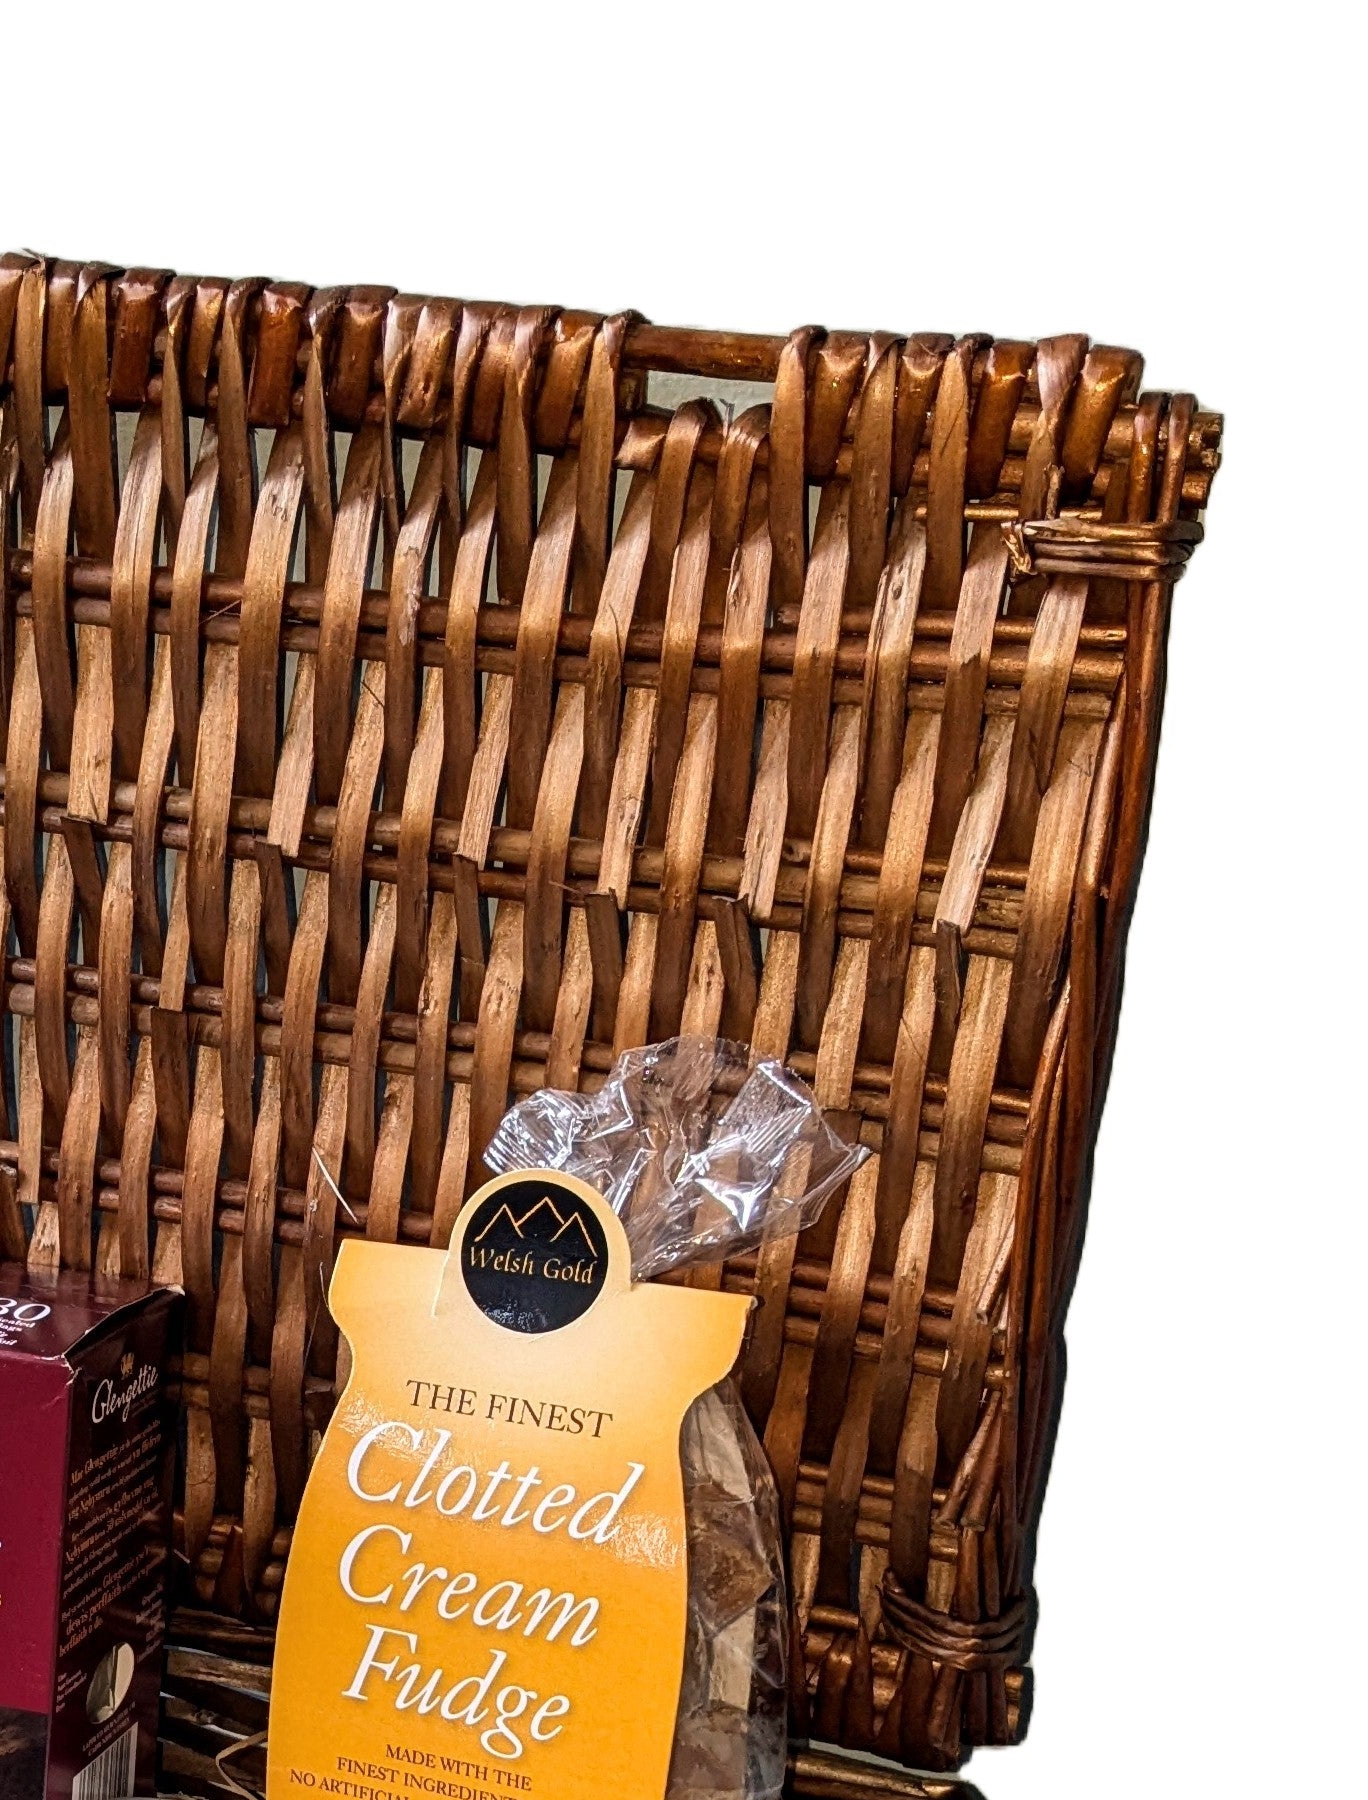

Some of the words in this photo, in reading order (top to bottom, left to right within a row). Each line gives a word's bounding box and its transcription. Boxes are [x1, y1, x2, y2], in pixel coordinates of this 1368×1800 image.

[468, 1246, 535, 1276] Welsh
[543, 1258, 599, 1286] Gold
[91, 1364, 159, 1424] Glengettie
[406, 1379, 478, 1415] THE
[488, 1394, 614, 1439] FINEST
[347, 1421, 646, 1544] Clotted
[339, 1523, 600, 1647] Cream
[341, 1623, 571, 1759] Fudge
[289, 1769, 316, 1788] NO
[336, 1756, 400, 1784] FINEST
[385, 1743, 437, 1769] MADE
[439, 1756, 488, 1781] WITH
[493, 1769, 533, 1792] THE
